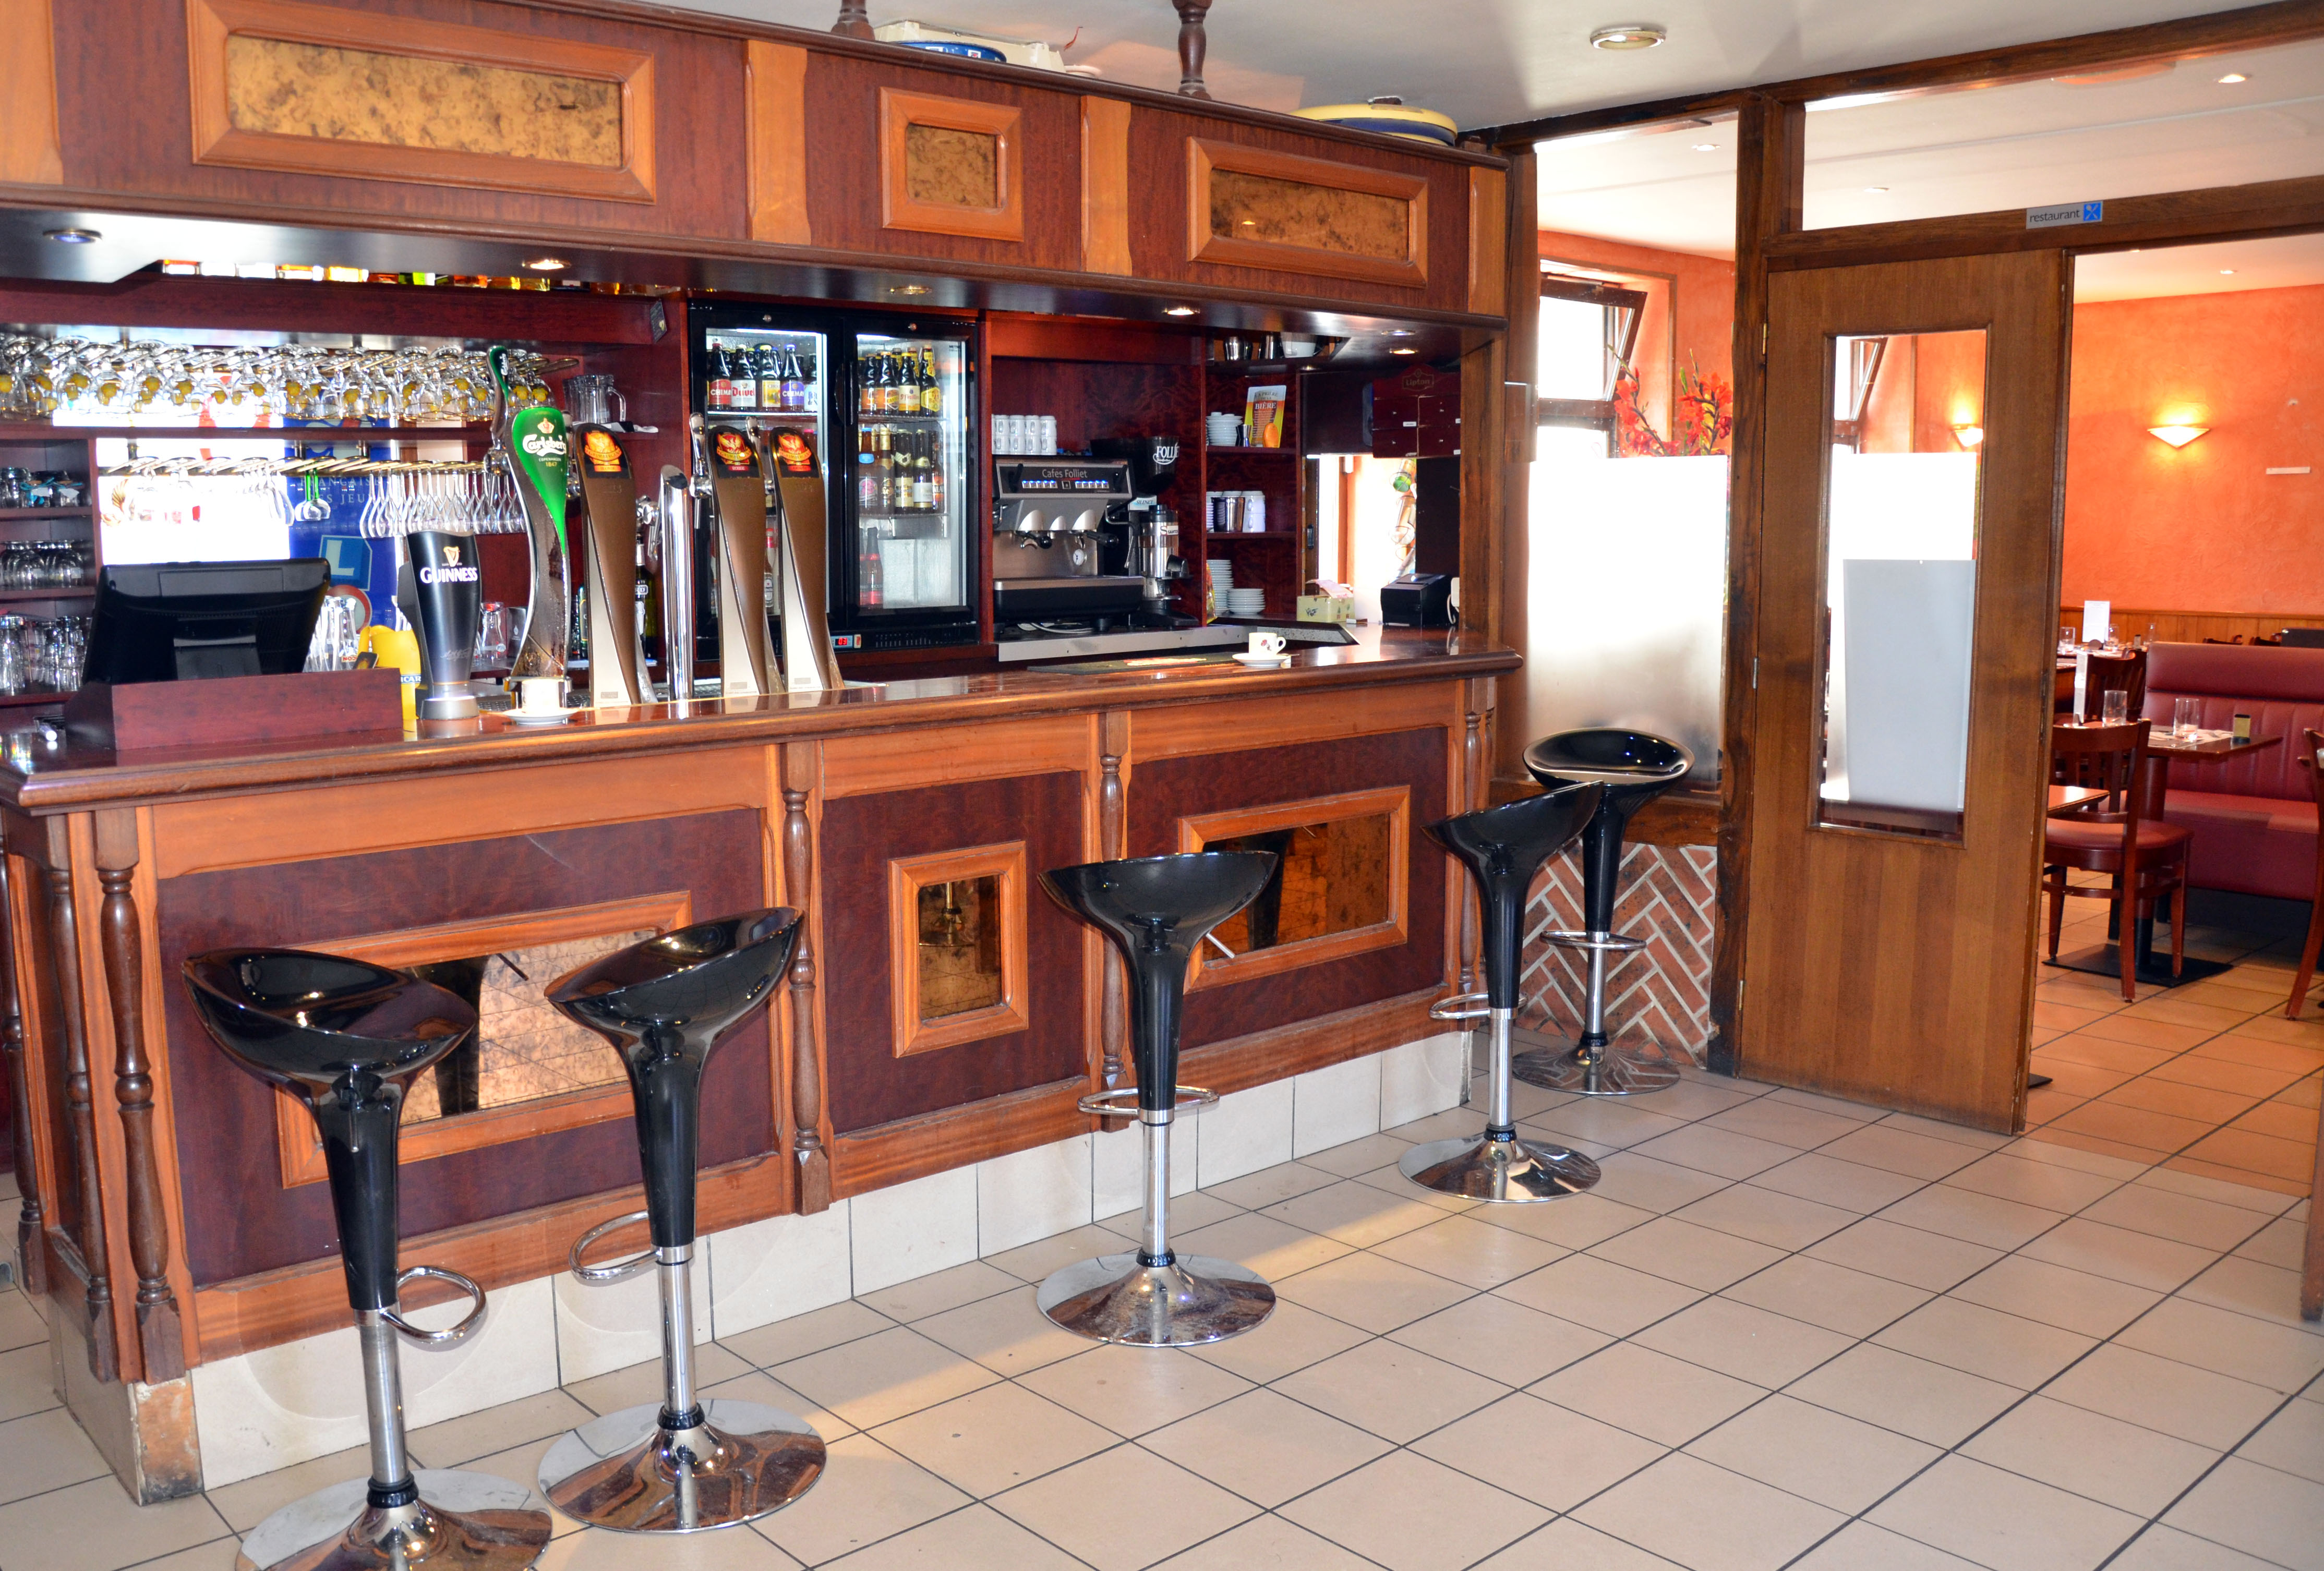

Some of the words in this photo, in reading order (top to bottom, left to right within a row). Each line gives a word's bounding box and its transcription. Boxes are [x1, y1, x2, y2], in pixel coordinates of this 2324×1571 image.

[2030, 210, 2080, 222] restaurant
[1406, 378, 1430, 386] Lipton
[732, 387, 755, 396] Duvel
[523, 434, 567, 456] Carlsberg
[1155, 442, 1180, 459] FOLLIE
[1065, 469, 1088, 478] Folliet
[340, 494, 370, 505] JEU
[420, 567, 478, 584] GUINNESS
